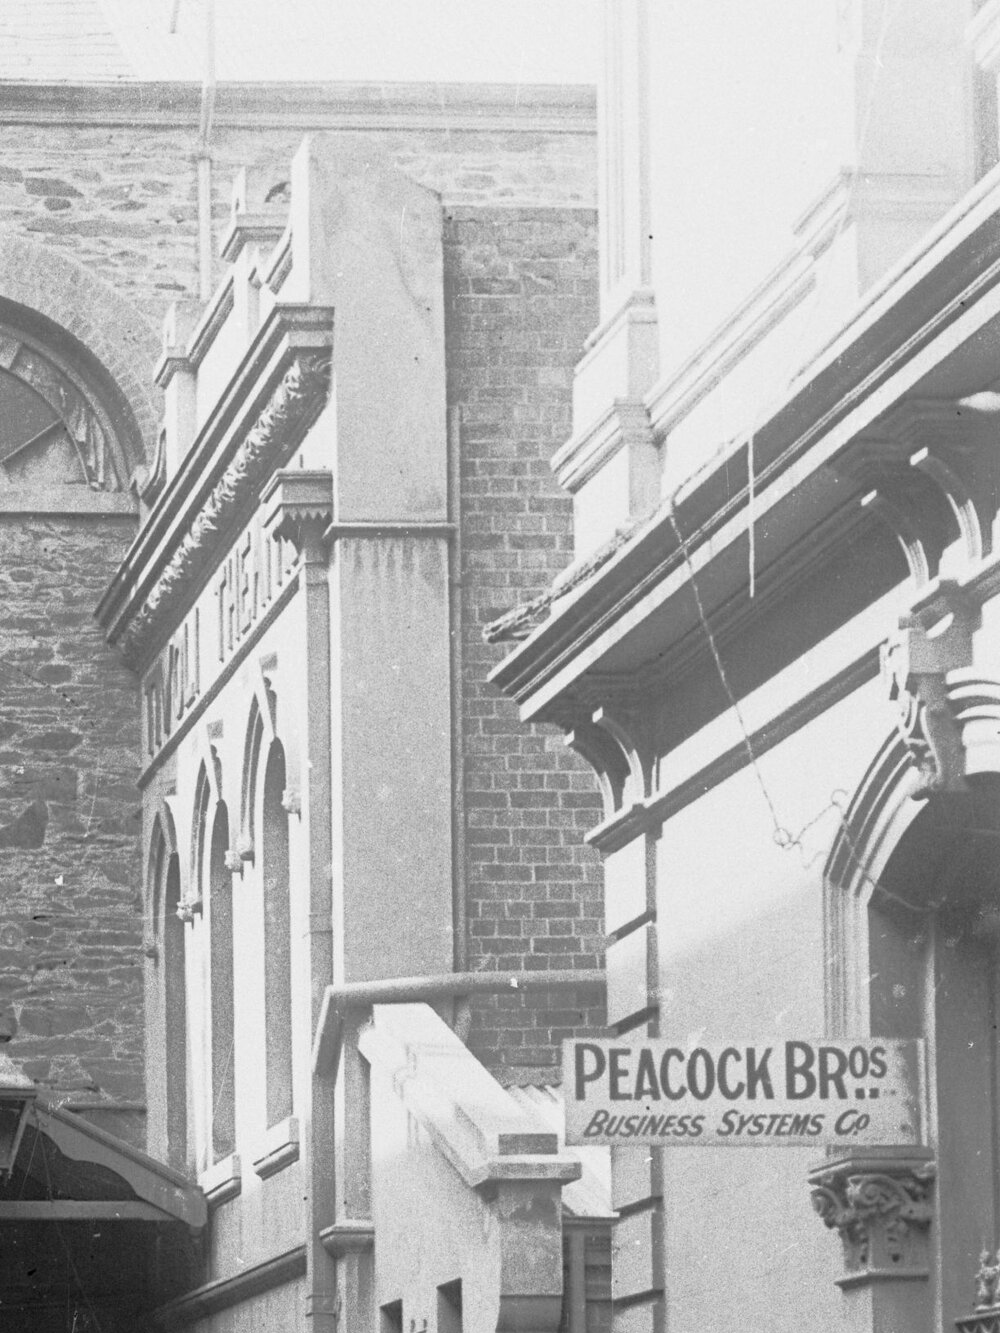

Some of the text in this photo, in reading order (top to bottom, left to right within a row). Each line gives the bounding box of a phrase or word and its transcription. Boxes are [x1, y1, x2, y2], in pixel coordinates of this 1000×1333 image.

[575, 1042, 775, 1101] PEACOCK
[583, 1109, 705, 1138] BUSINESS
[716, 1109, 826, 1137] SYSTEMS
